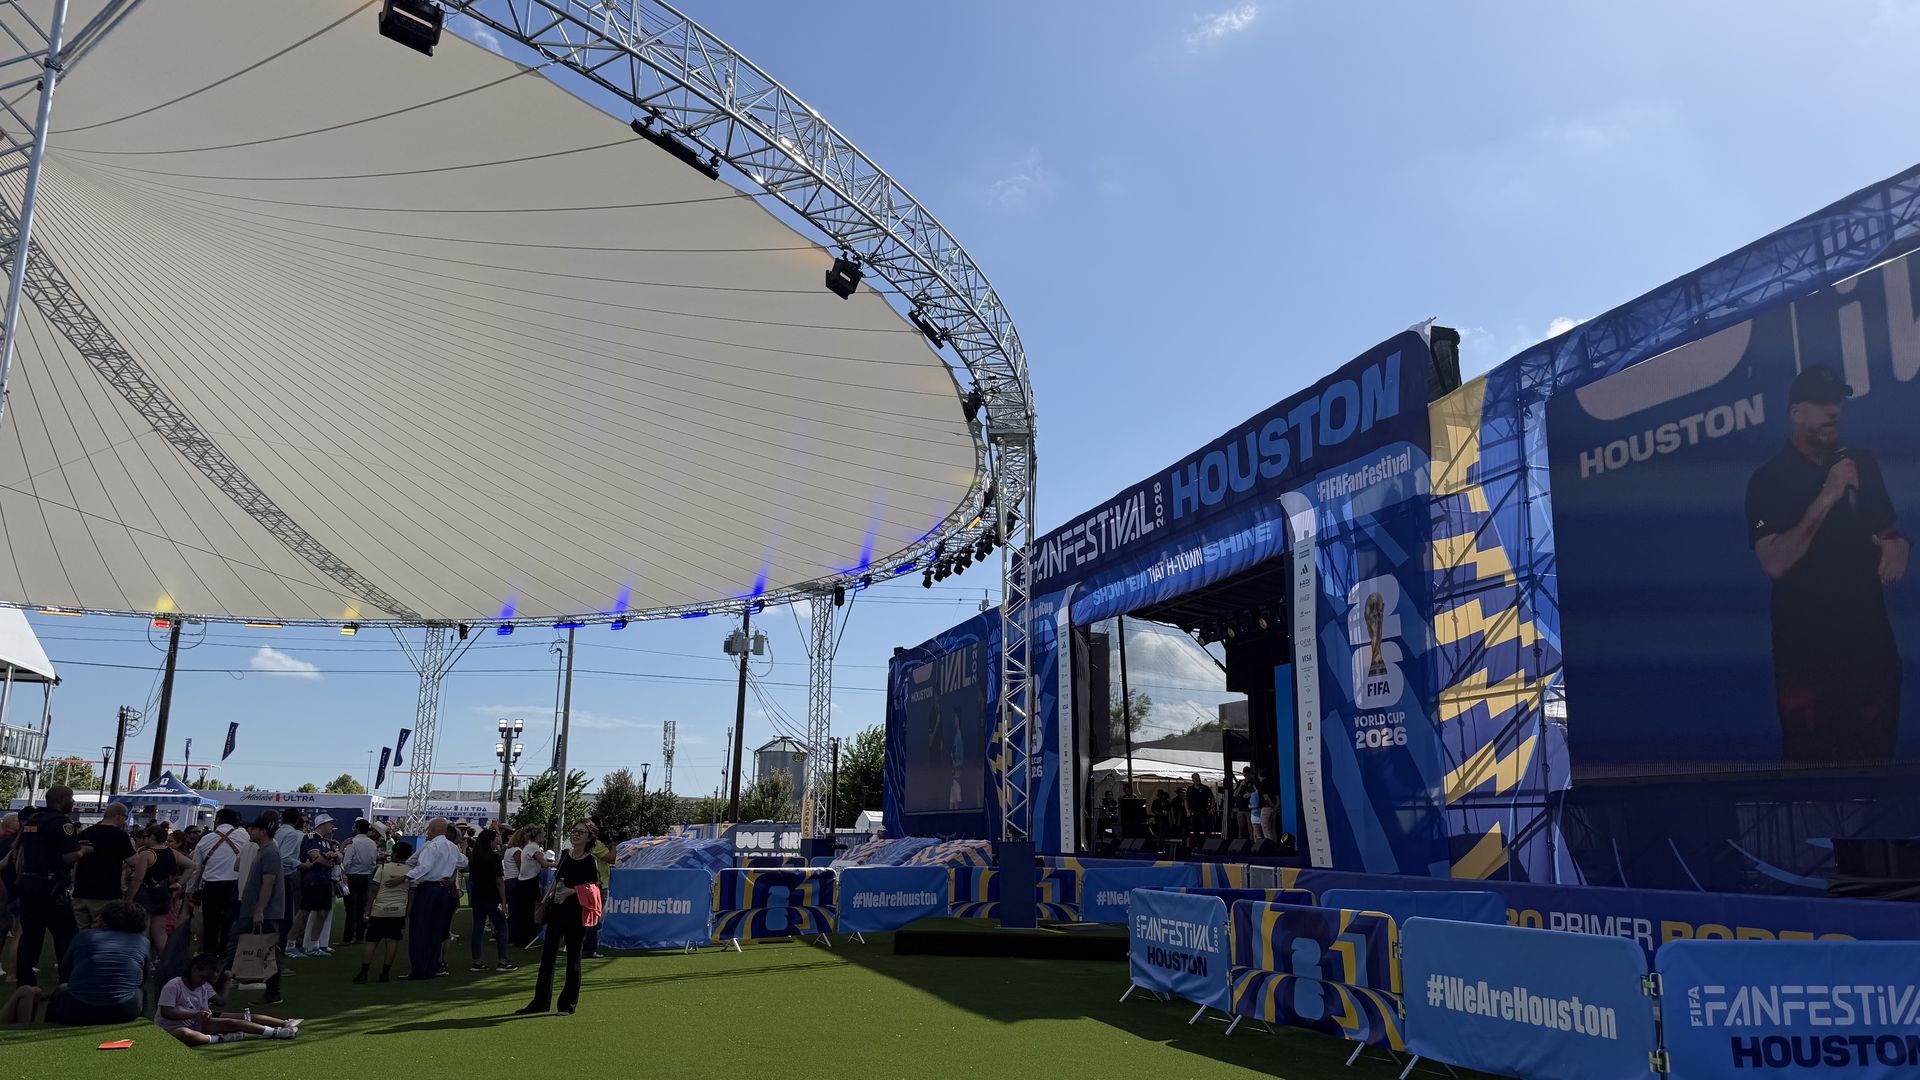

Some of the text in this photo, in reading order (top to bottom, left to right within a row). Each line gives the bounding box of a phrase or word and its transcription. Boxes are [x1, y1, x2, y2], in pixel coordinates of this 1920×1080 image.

[1154, 482, 1165, 528] 2026
[1171, 350, 1402, 521] HOUSTON
[1579, 394, 1765, 479] HOUSTON
[1093, 579, 1125, 606] SHOW
[1166, 546, 1204, 577] H-TOWN
[1202, 521, 1272, 562] SHINE
[1301, 653, 1313, 664] VISA
[1367, 681, 1391, 697] FIFA
[1387, 711, 1406, 724] CUP
[1355, 726, 1408, 750] 2026
[735, 831, 776, 849] WE
[852, 890, 938, 909] #WeAreHouston
[1147, 945, 1208, 977] HOUSTON
[1426, 973, 1617, 1040] #WeAreHouston
[1687, 985, 1703, 1027] FIFA
